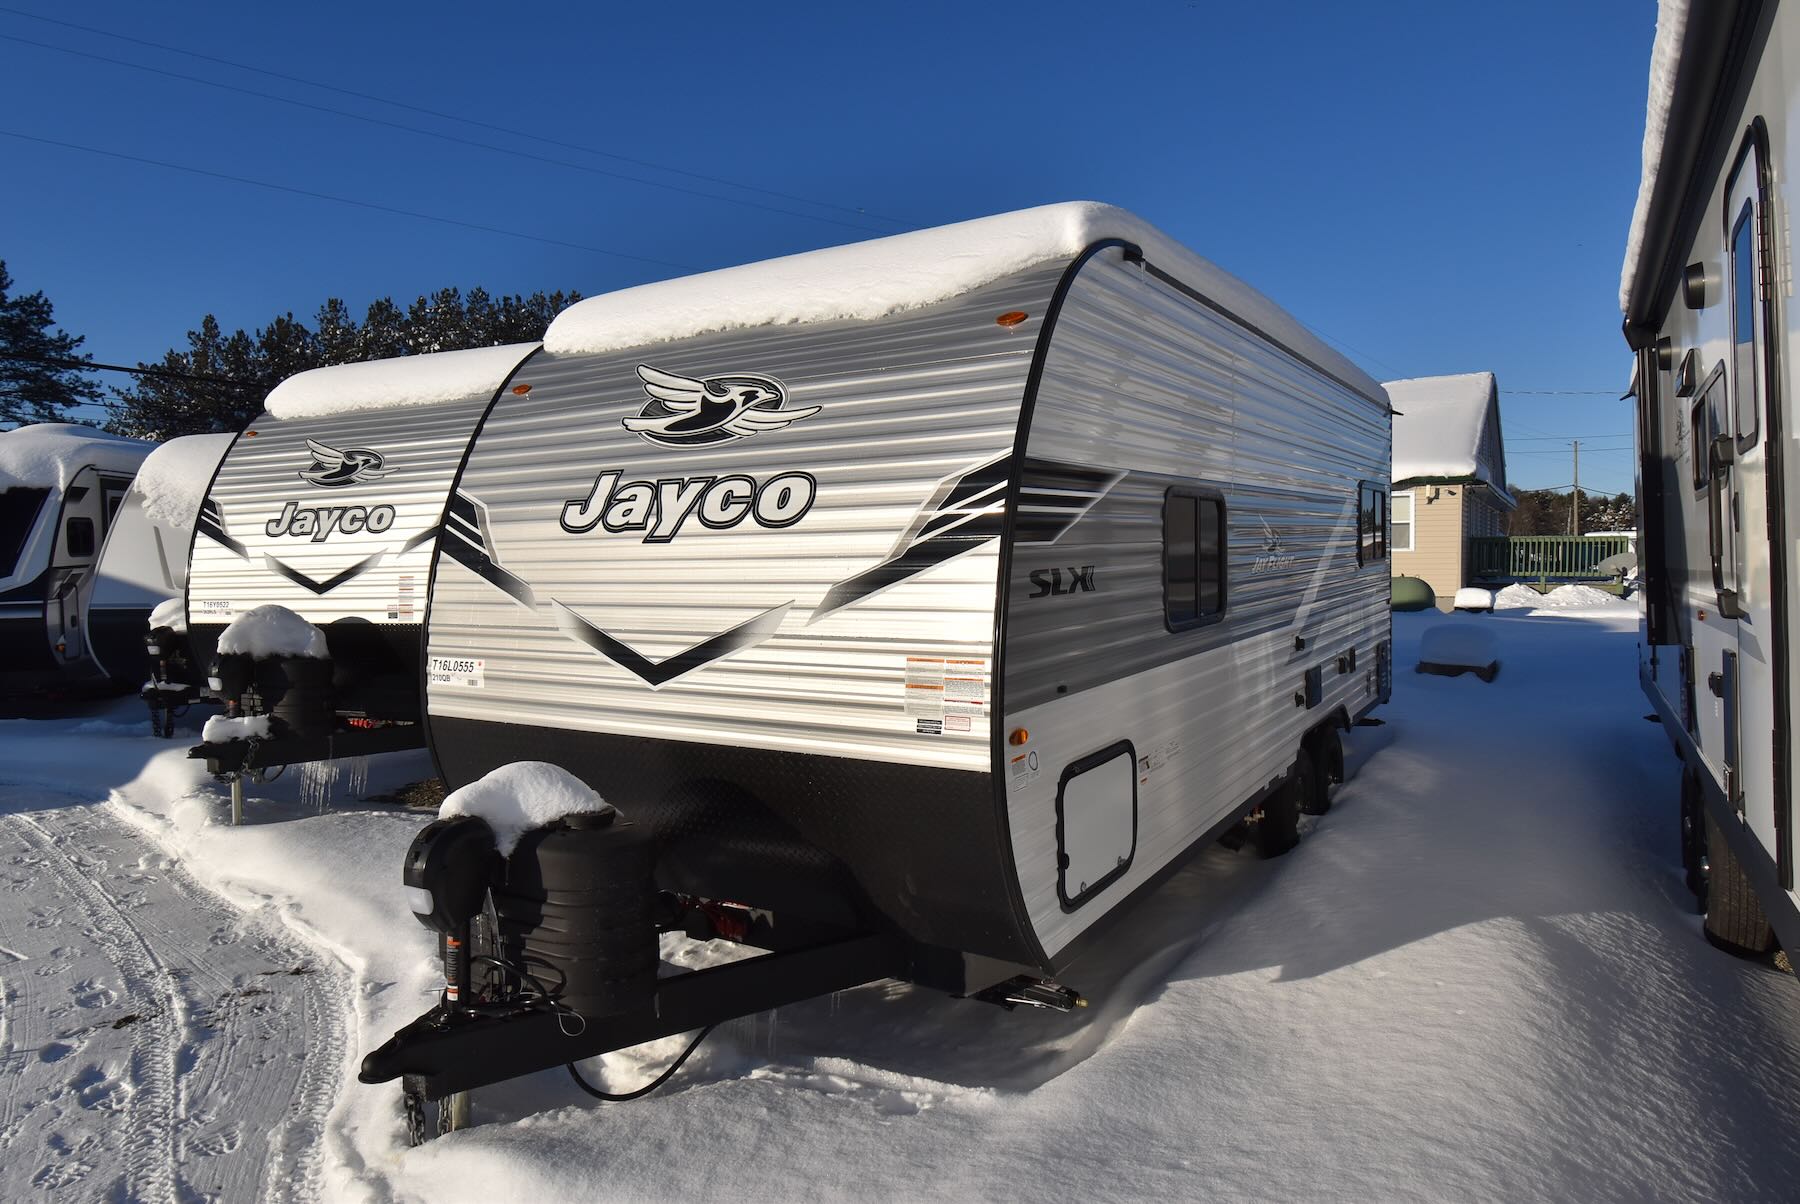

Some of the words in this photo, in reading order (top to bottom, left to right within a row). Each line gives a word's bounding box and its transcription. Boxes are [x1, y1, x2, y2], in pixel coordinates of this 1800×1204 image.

[266, 502, 396, 542] Jayco
[560, 469, 817, 543] Jayco
[1029, 566, 1095, 598] SLX
[433, 659, 475, 672] T16L0555
